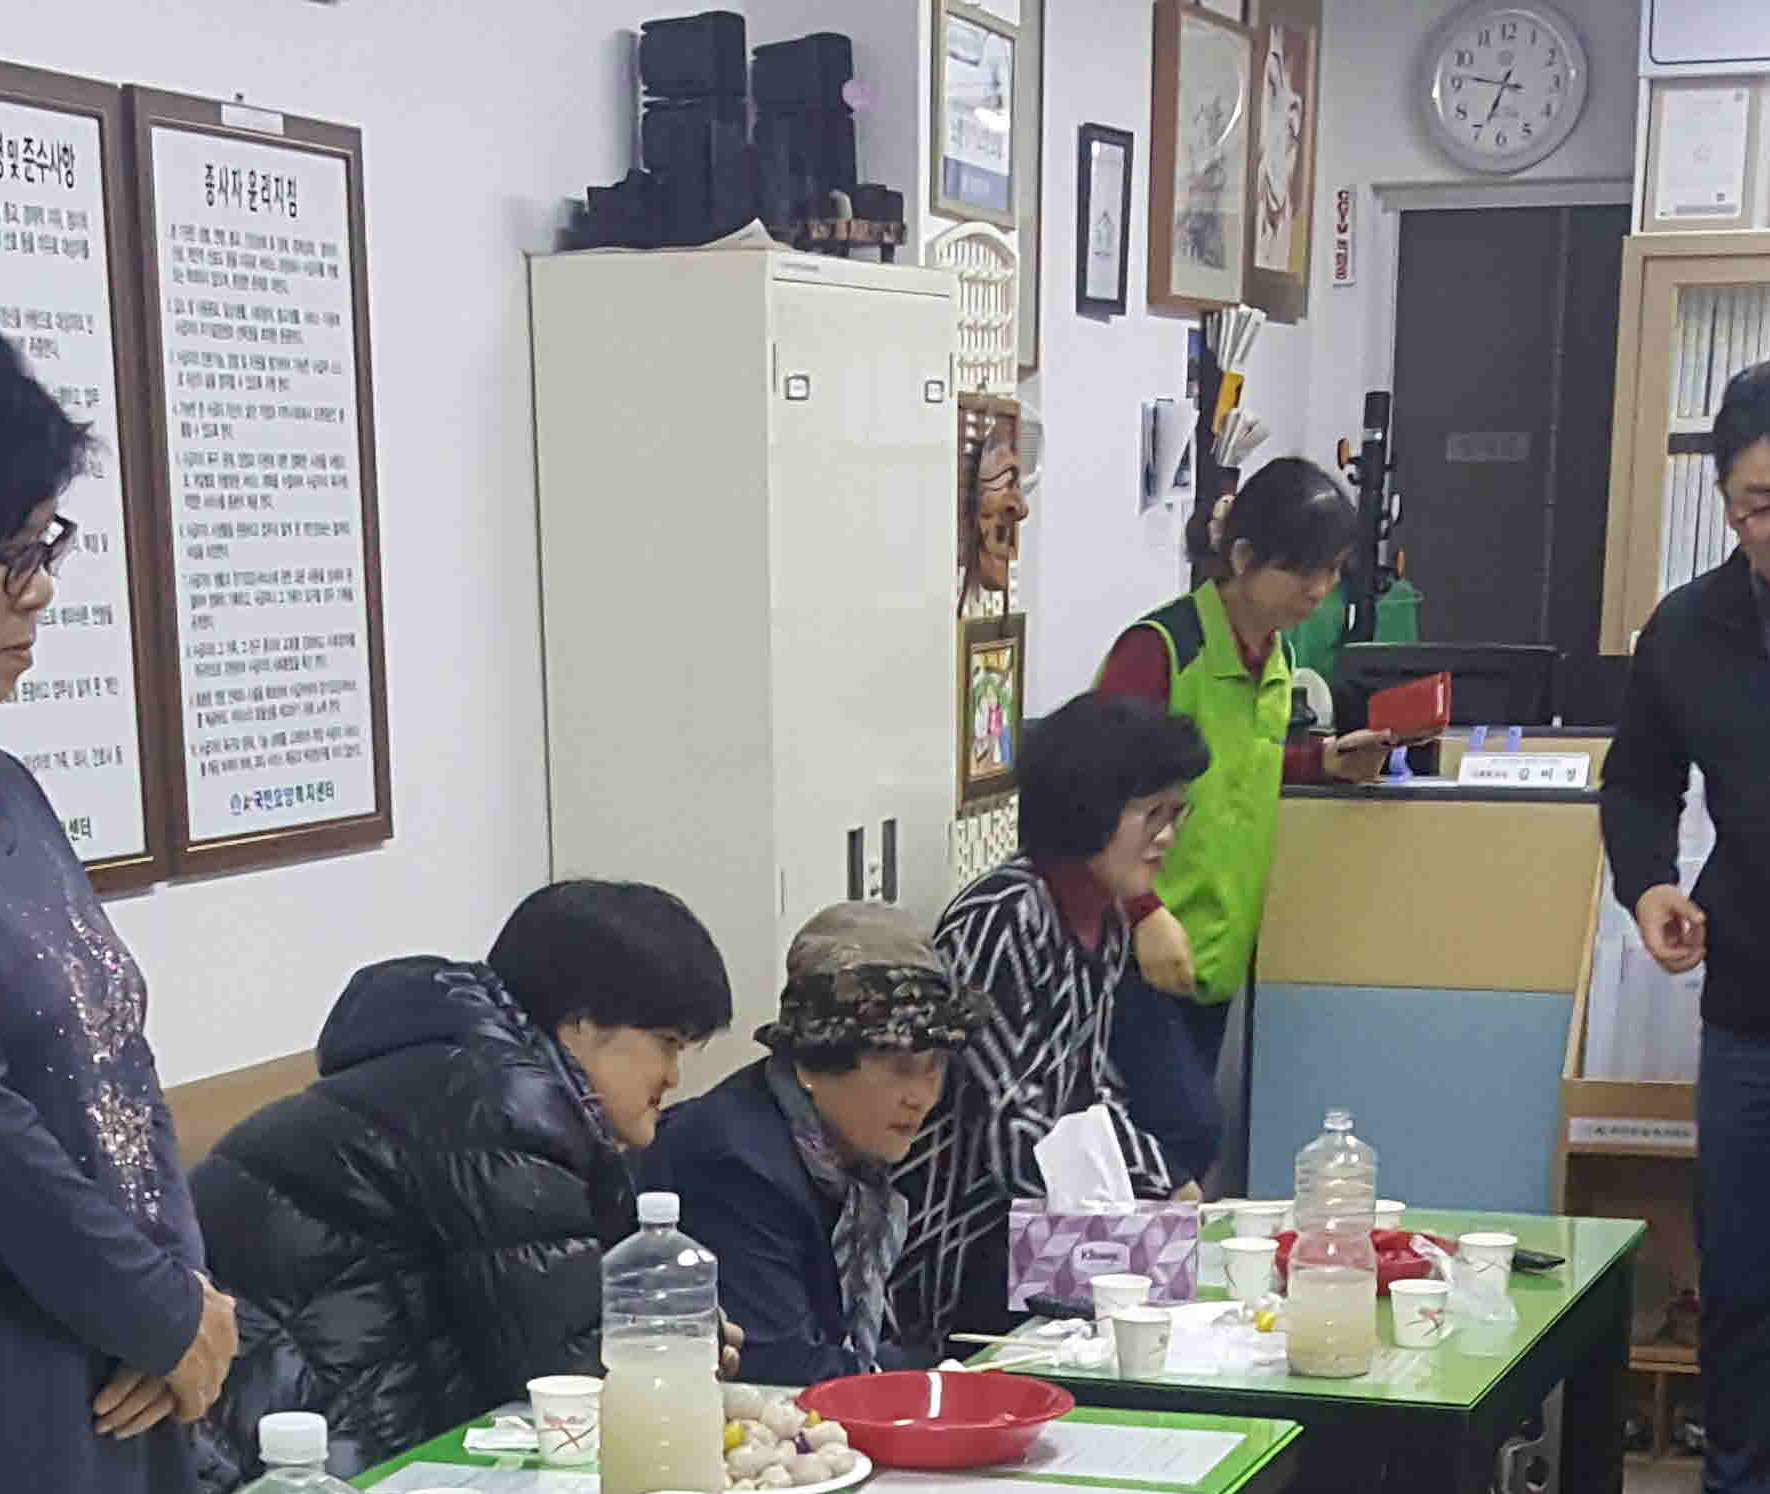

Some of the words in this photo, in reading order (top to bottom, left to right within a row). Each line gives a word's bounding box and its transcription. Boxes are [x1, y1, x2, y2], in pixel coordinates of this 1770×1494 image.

[1478, 28, 1490, 47] 11
[1501, 23, 1517, 41] 12
[1454, 49, 1474, 67] 10
[1450, 76, 1463, 94] 9
[1455, 103, 1468, 121] 8
[1495, 130, 1508, 147] 6
[7, 139, 21, 179] 및
[22, 136, 76, 189] 준수사항
[204, 163, 244, 209] 종사자
[247, 169, 299, 219] 윤리지침
